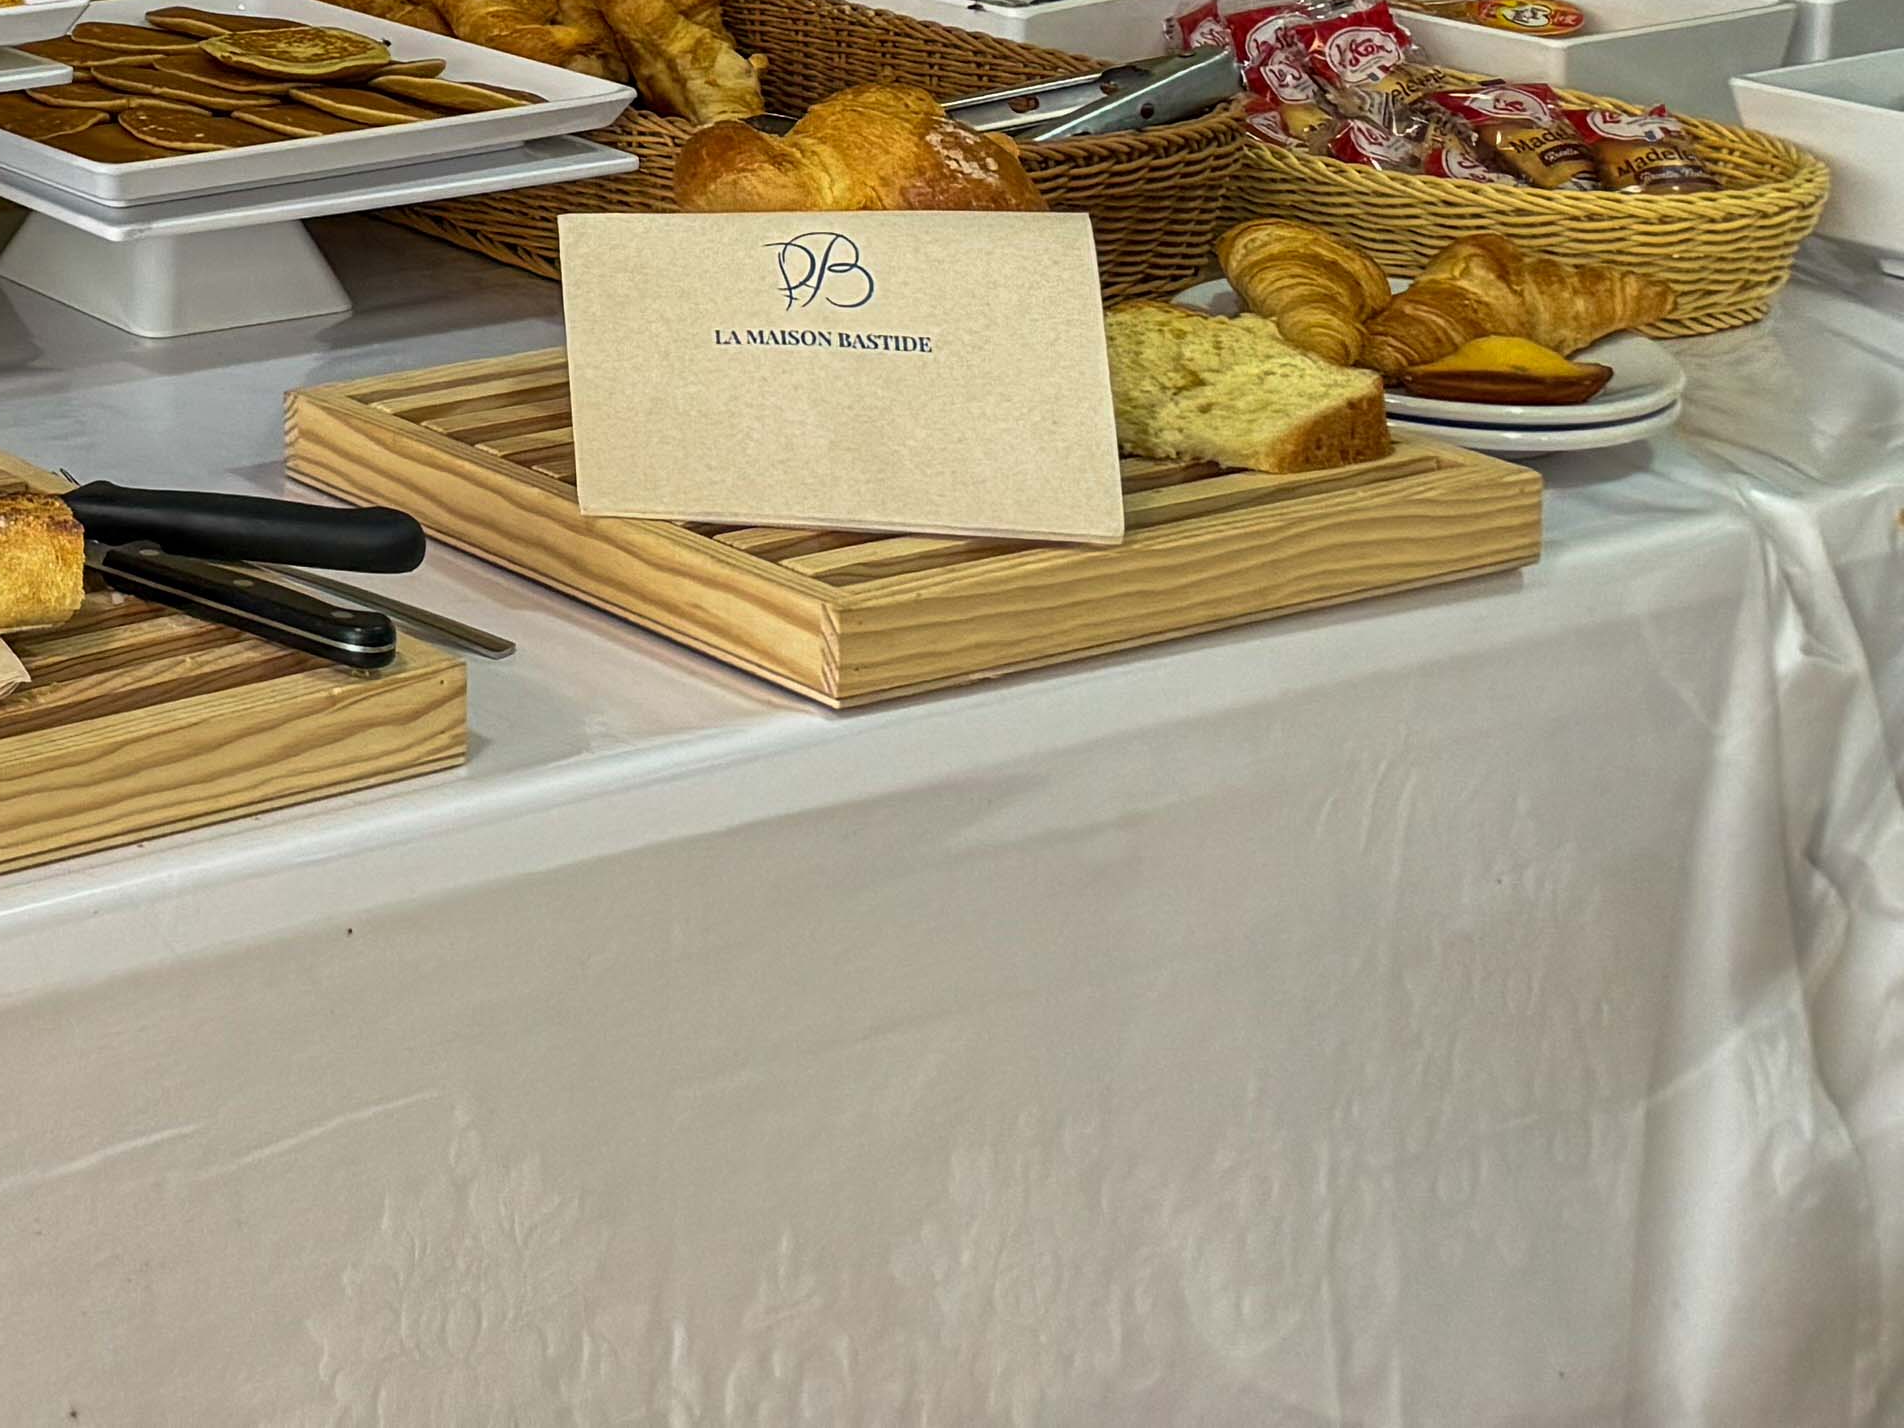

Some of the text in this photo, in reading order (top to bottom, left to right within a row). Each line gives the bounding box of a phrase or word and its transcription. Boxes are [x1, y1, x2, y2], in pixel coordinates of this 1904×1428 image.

[714, 329, 933, 353] LA MAISON BASTIDE
